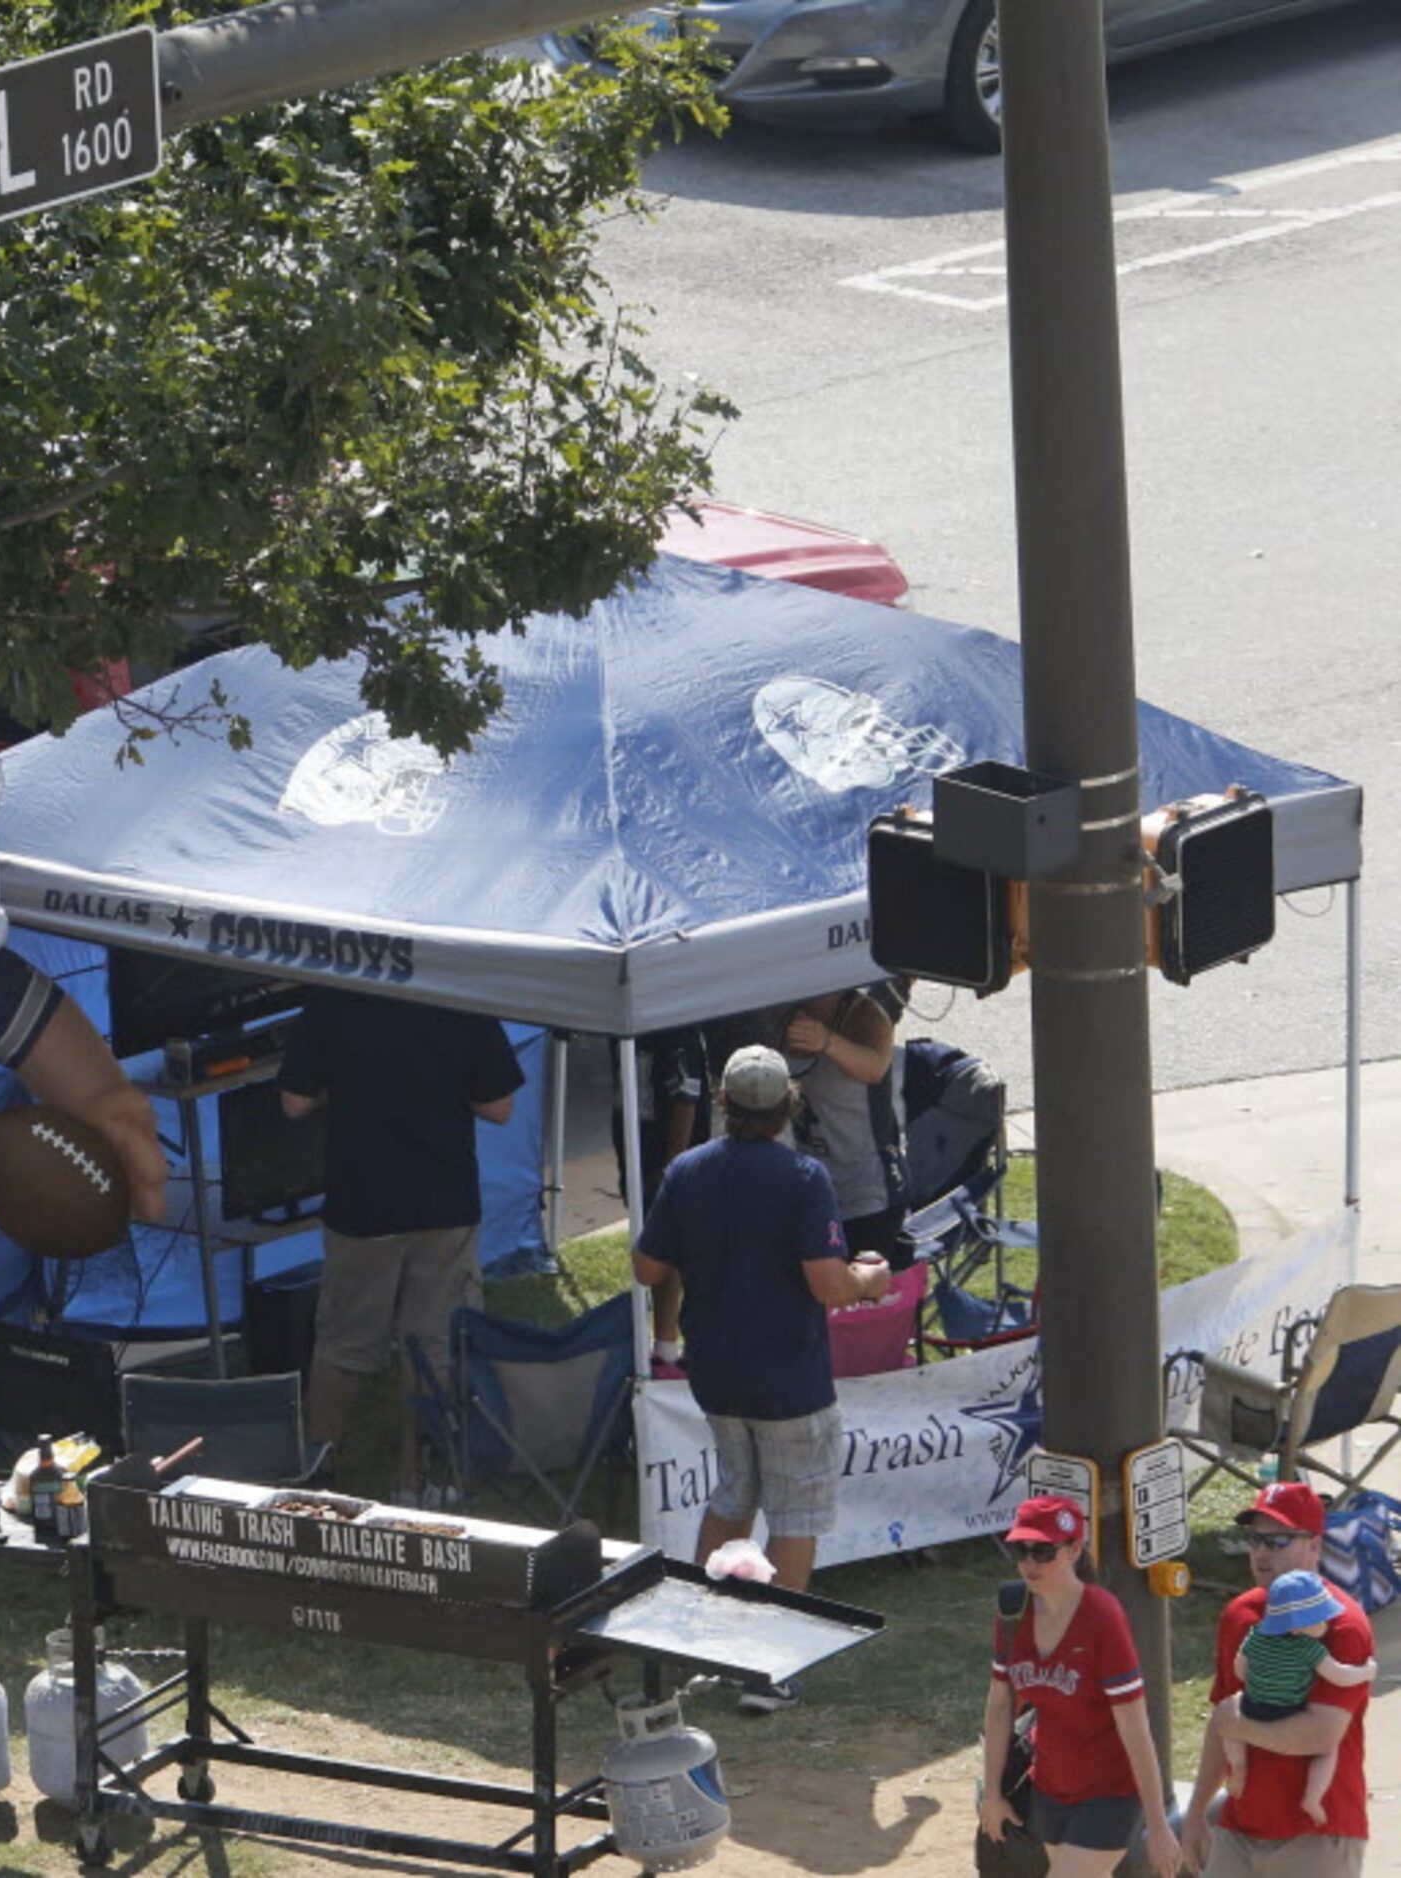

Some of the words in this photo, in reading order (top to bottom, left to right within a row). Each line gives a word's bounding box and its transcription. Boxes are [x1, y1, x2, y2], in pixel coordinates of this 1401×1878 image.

[74, 60, 113, 112] RD
[61, 116, 133, 177] 1600
[43, 888, 150, 925] DALLAS
[207, 911, 414, 984] COWBOYS
[841, 1415, 963, 1477] Trash
[146, 1496, 223, 1535] TALKING
[235, 1511, 296, 1547] TRASH
[318, 1523, 406, 1564] TAILGATE
[420, 1537, 472, 1572] BASH
